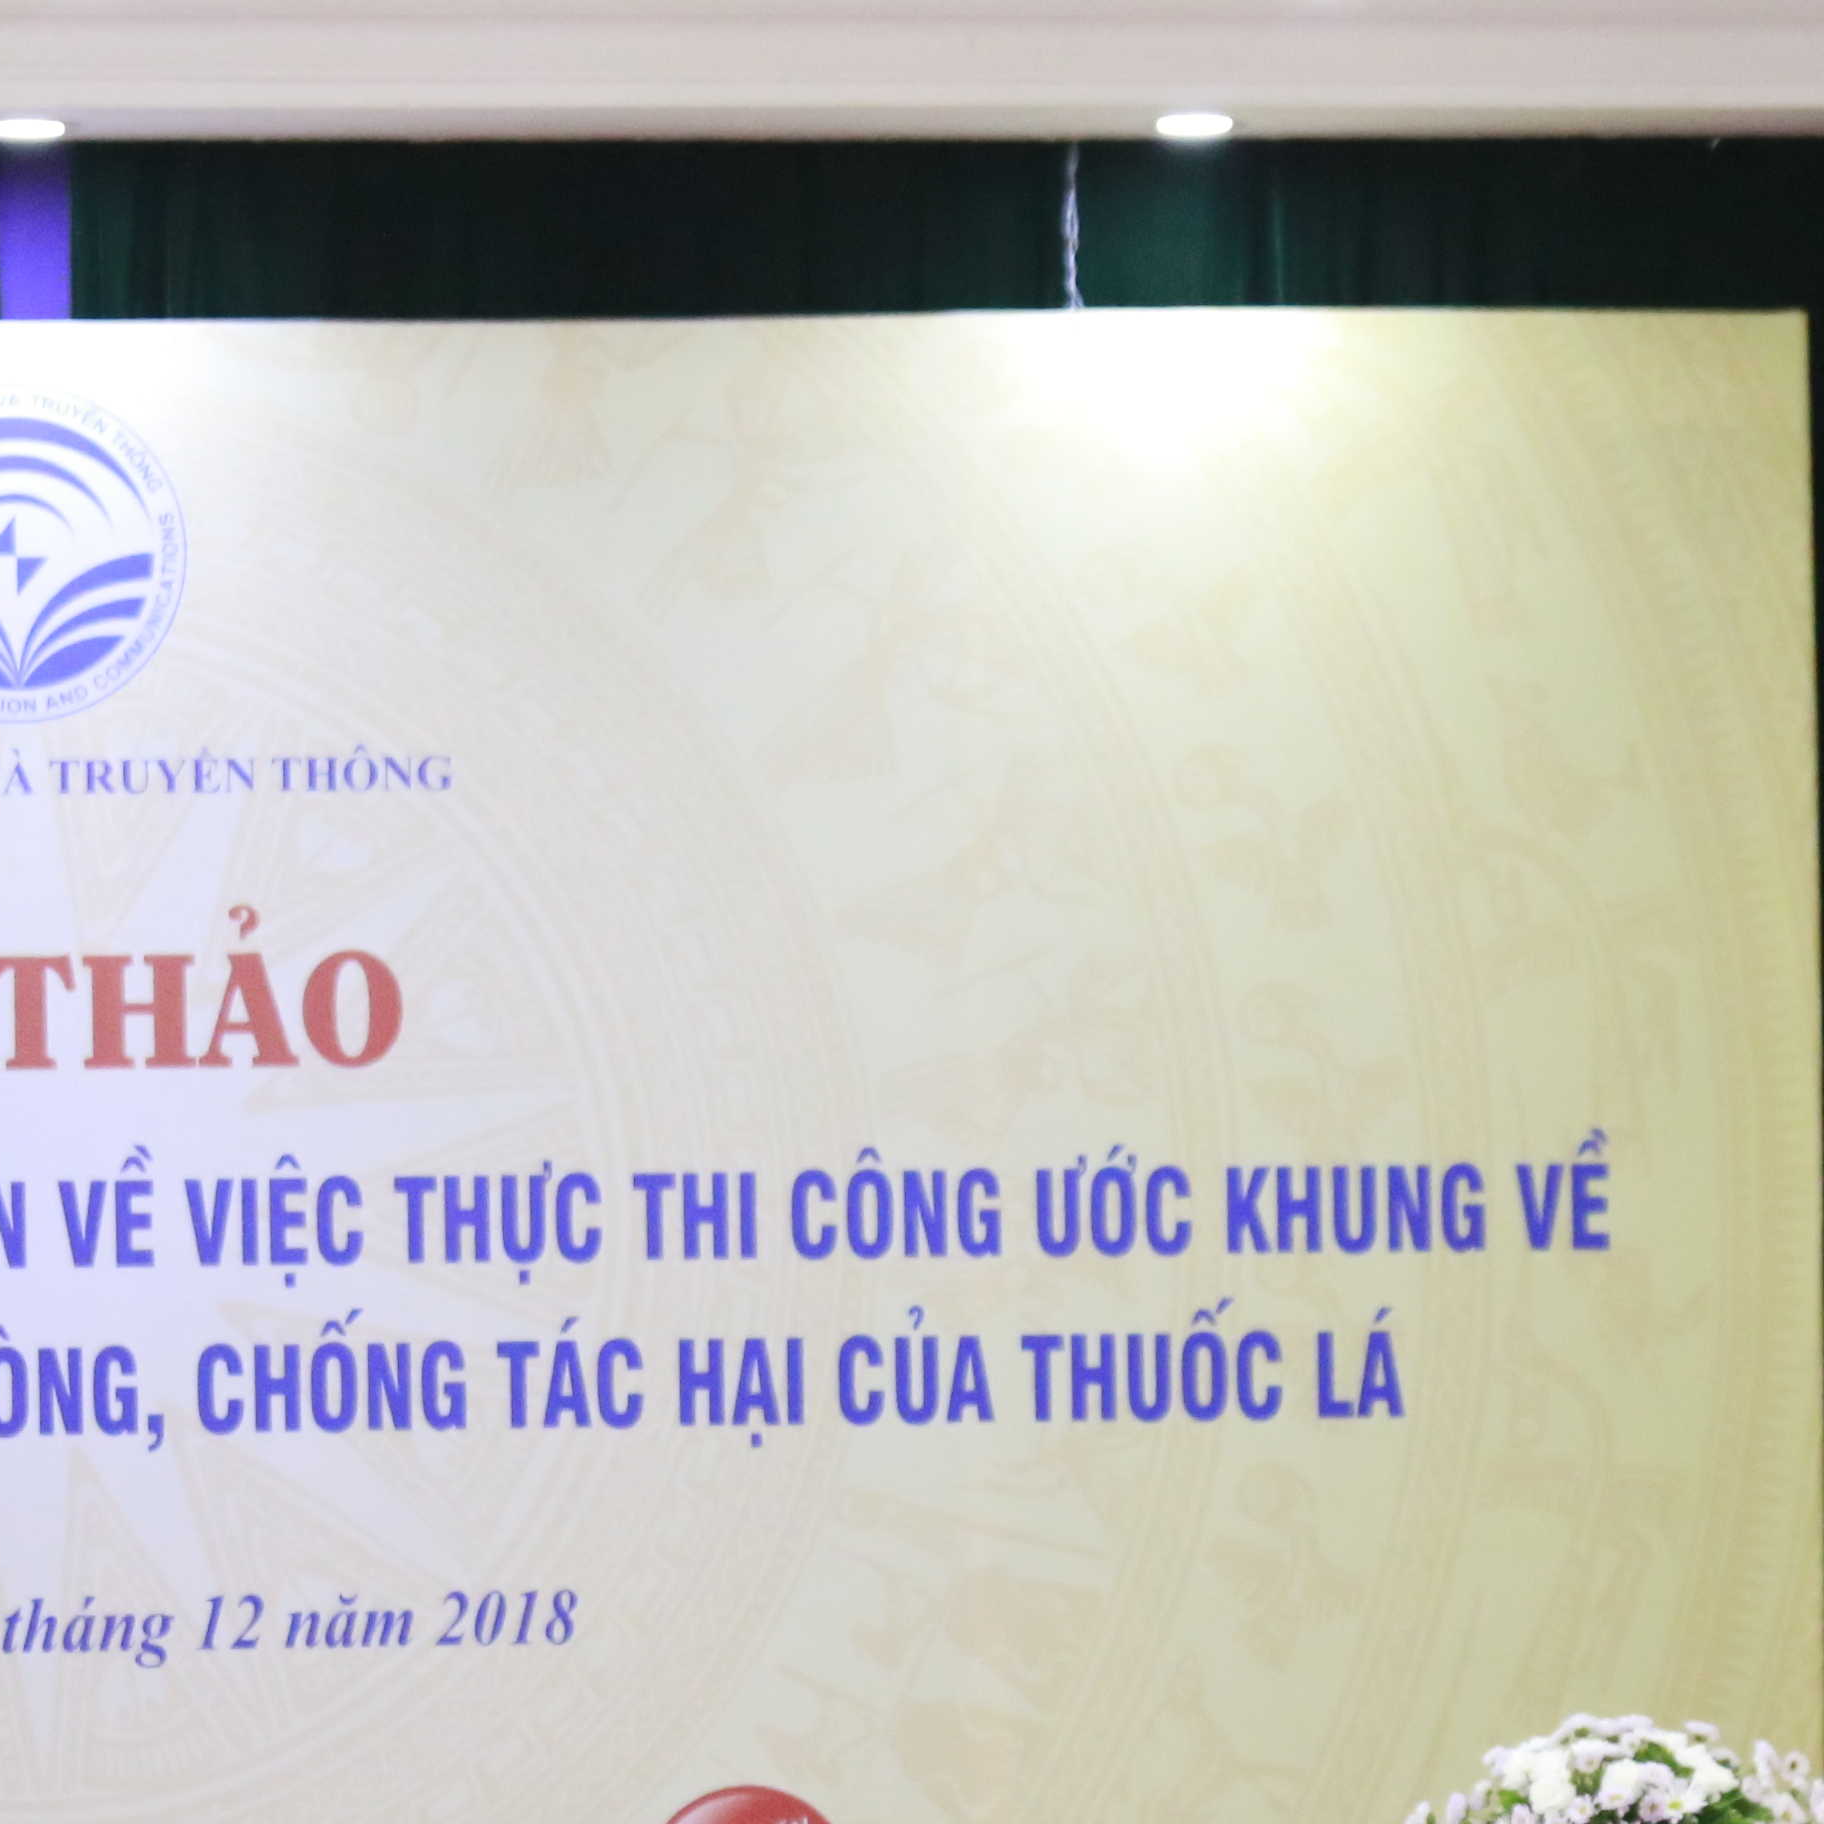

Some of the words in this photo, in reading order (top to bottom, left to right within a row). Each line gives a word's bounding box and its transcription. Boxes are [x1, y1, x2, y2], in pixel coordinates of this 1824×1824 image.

[46, 686, 88, 712] AND
[49, 746, 256, 796] TRUYỀN
[272, 744, 452, 794] THÔNG
[60, 1146, 154, 1267] VỀ
[186, 1155, 362, 1288] VIỆC
[395, 1162, 601, 1283] THỰC
[633, 1172, 756, 1260] THI
[791, 1148, 1001, 1260] CÔNG
[1036, 1145, 1191, 1256] ƯỚC
[1226, 1164, 1484, 1254] KHUNG
[1516, 1131, 1609, 1250] VỀ
[198, 1309, 466, 1434] CHỐNG
[497, 1318, 643, 1429] TÁC
[679, 1335, 805, 1448] HẠI
[839, 1307, 993, 1426] CỦA
[1020, 1300, 1281, 1422] THUỐC
[1317, 1309, 1404, 1418] LÁ
[2, 1595, 175, 1668] tháng
[198, 1594, 264, 1650] 12
[285, 1593, 414, 1650] năm
[434, 1590, 581, 1648] 2018
